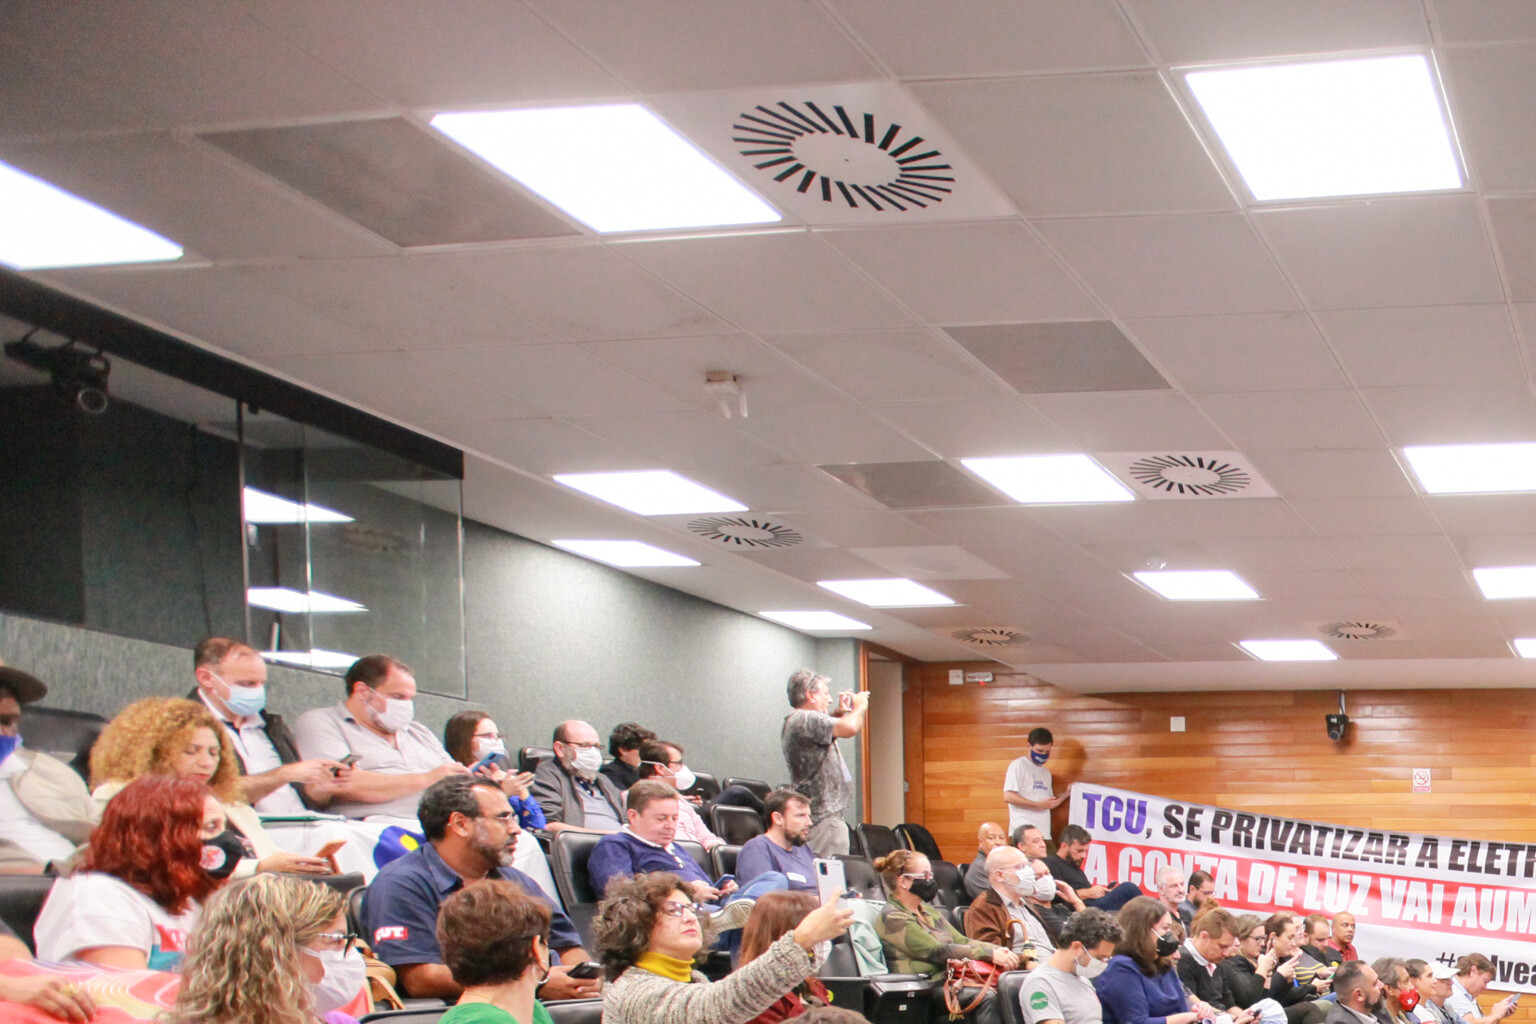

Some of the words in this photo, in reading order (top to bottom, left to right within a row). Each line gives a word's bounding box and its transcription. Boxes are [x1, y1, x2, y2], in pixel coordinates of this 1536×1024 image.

[1082, 792, 1153, 840] TCU,
[1163, 803, 1205, 842] SE
[1211, 807, 1410, 866] PRIVATIZAR
[1415, 837, 1439, 869] A
[1083, 843, 1109, 886] A
[1247, 862, 1299, 908] DE
[1303, 869, 1372, 916] LUZ
[1380, 876, 1444, 925] VAI
